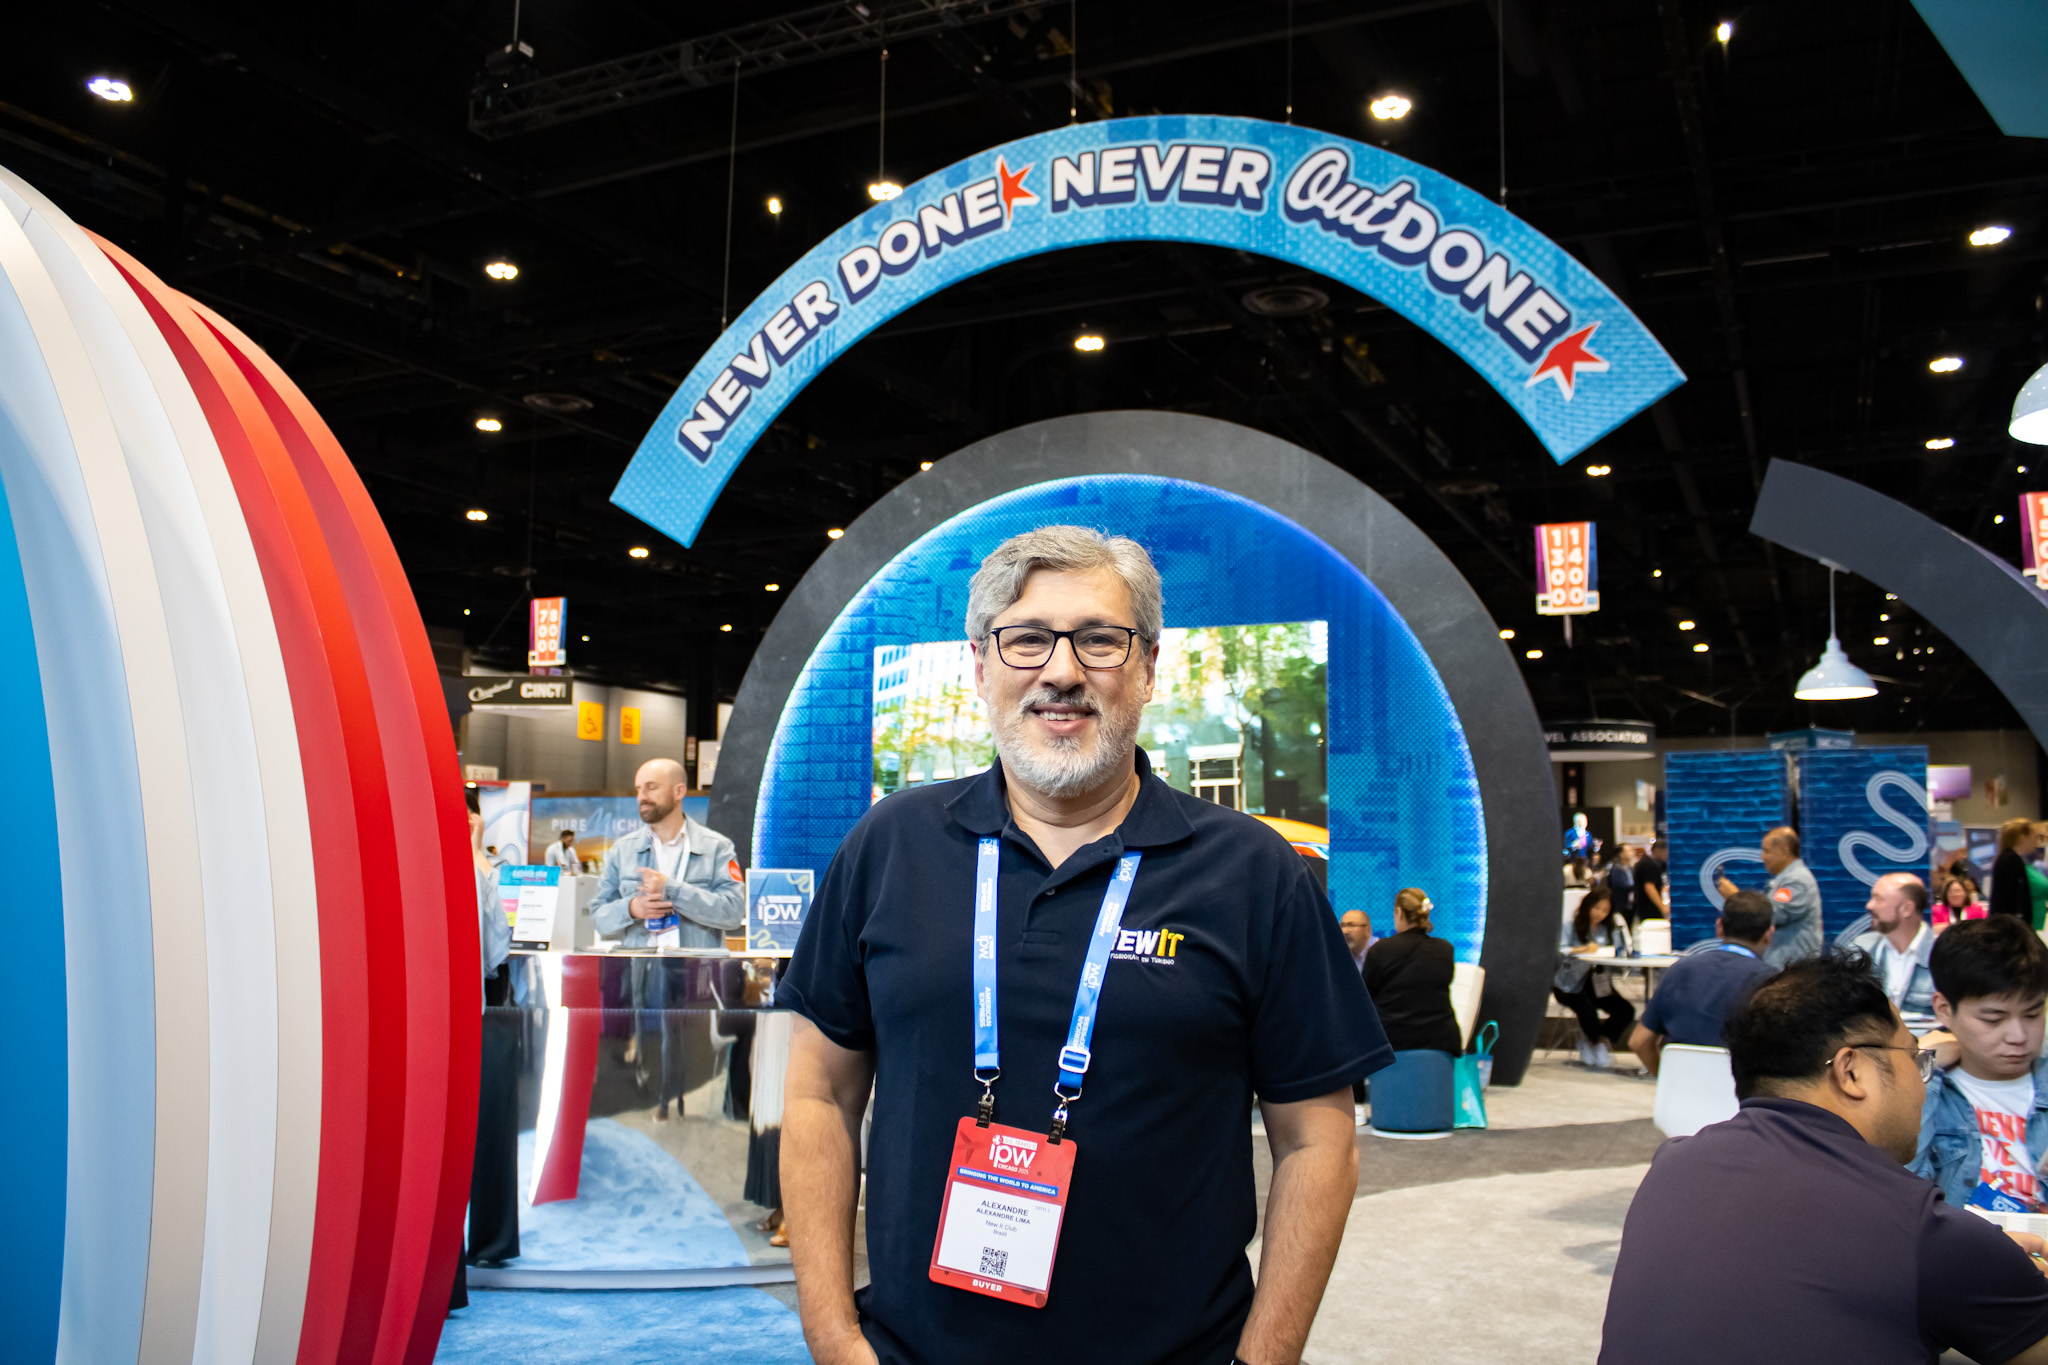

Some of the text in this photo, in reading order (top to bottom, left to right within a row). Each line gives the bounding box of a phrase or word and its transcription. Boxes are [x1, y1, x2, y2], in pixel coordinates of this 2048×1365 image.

[679, 281, 838, 462] NEVER
[838, 177, 1003, 304] DONE
[1051, 144, 1270, 212] NEVER
[1544, 730, 1648, 744] VEL ASSOCIATION
[551, 818, 587, 832] PURE
[758, 897, 802, 926] ipw
[978, 992, 986, 1028] EXPRESS
[989, 1136, 1036, 1168] ipw
[998, 1163, 1018, 1173] CHICAGO
[959, 1168, 987, 1180] BRINGING
[987, 1174, 999, 1182] THE
[999, 1177, 1020, 1187] WORLD
[1030, 1184, 1056, 1195] AMERICA
[981, 1200, 1029, 1216] ALEXANDRE
[976, 1208, 1031, 1225] ALEXANDRE LIMA
[985, 1220, 998, 1228] New
[1004, 1224, 1017, 1232] Club
[993, 1229, 1007, 1237] Brazil
[972, 1279, 1003, 1293] BUYER
